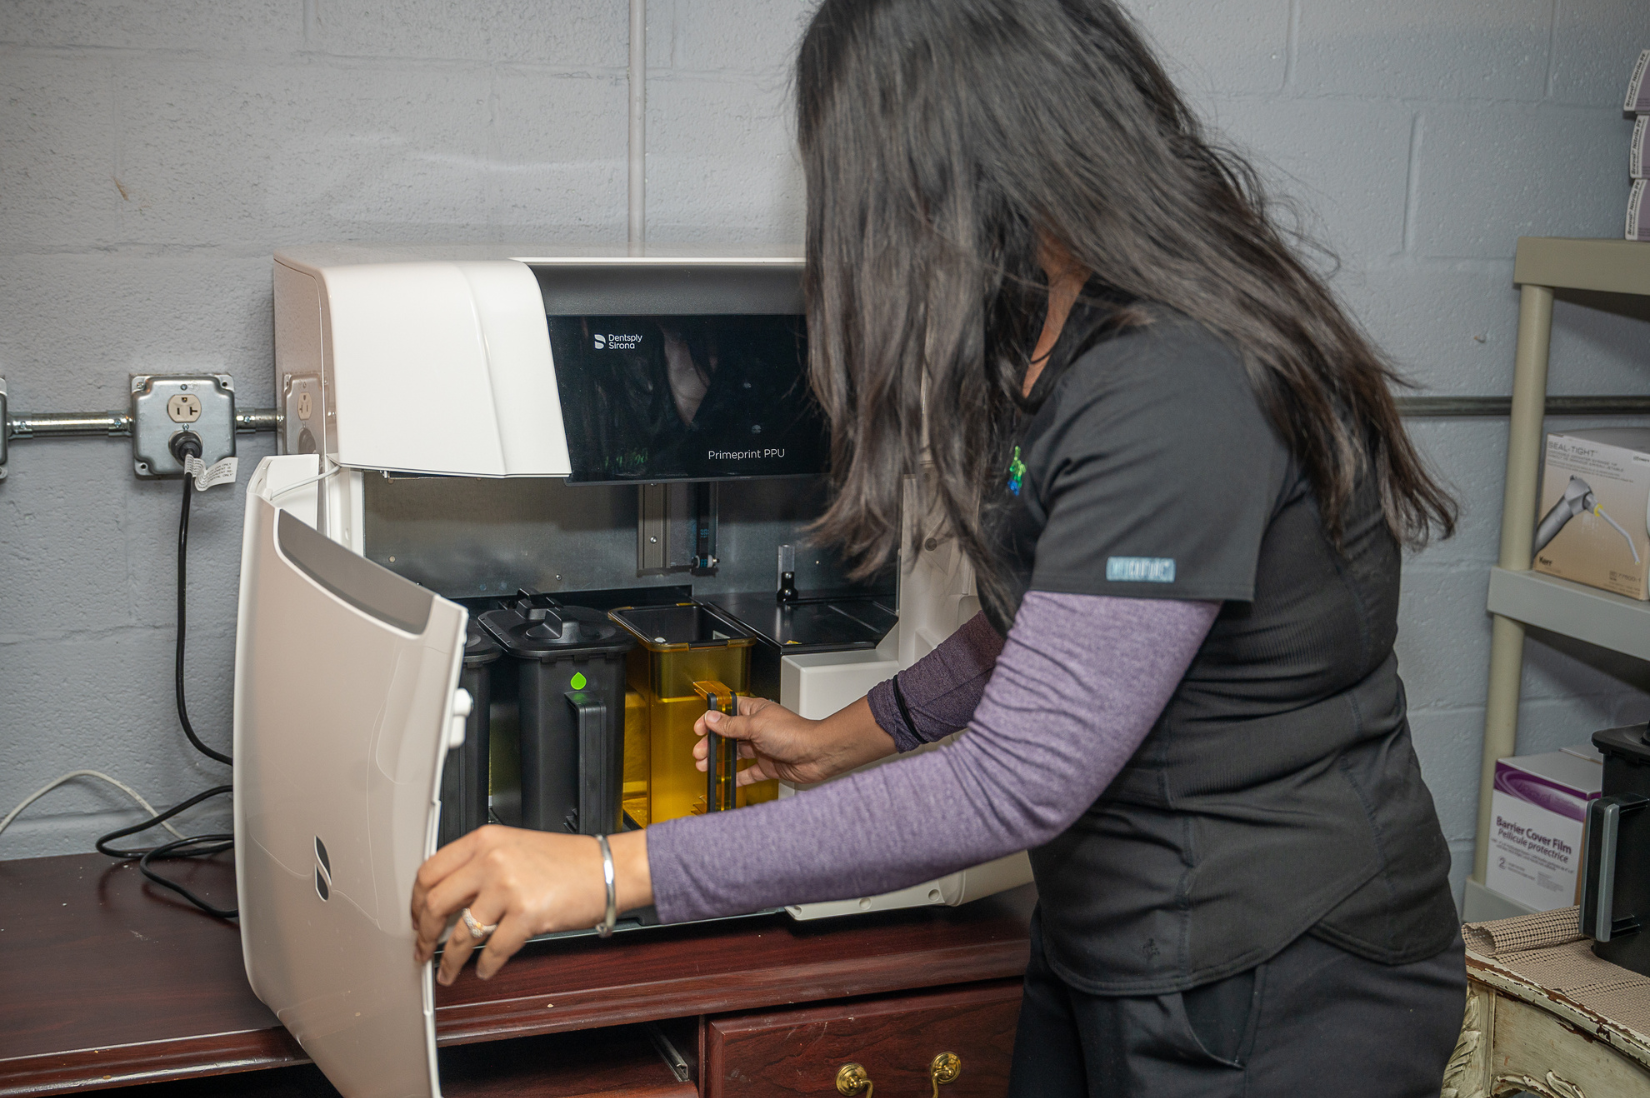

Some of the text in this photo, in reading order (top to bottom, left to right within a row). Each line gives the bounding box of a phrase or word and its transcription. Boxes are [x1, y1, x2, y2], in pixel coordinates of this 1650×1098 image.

[608, 334, 643, 343] Dentsply
[608, 342, 635, 350] Sirona
[708, 449, 785, 461] Primeprint PPU
[1539, 556, 1552, 567] Kerr
[1496, 816, 1572, 855] Barrier Cover Film
[1498, 828, 1528, 847] Pellicule
[1528, 841, 1569, 864] protectrice
[1498, 857, 1507, 870] 2
